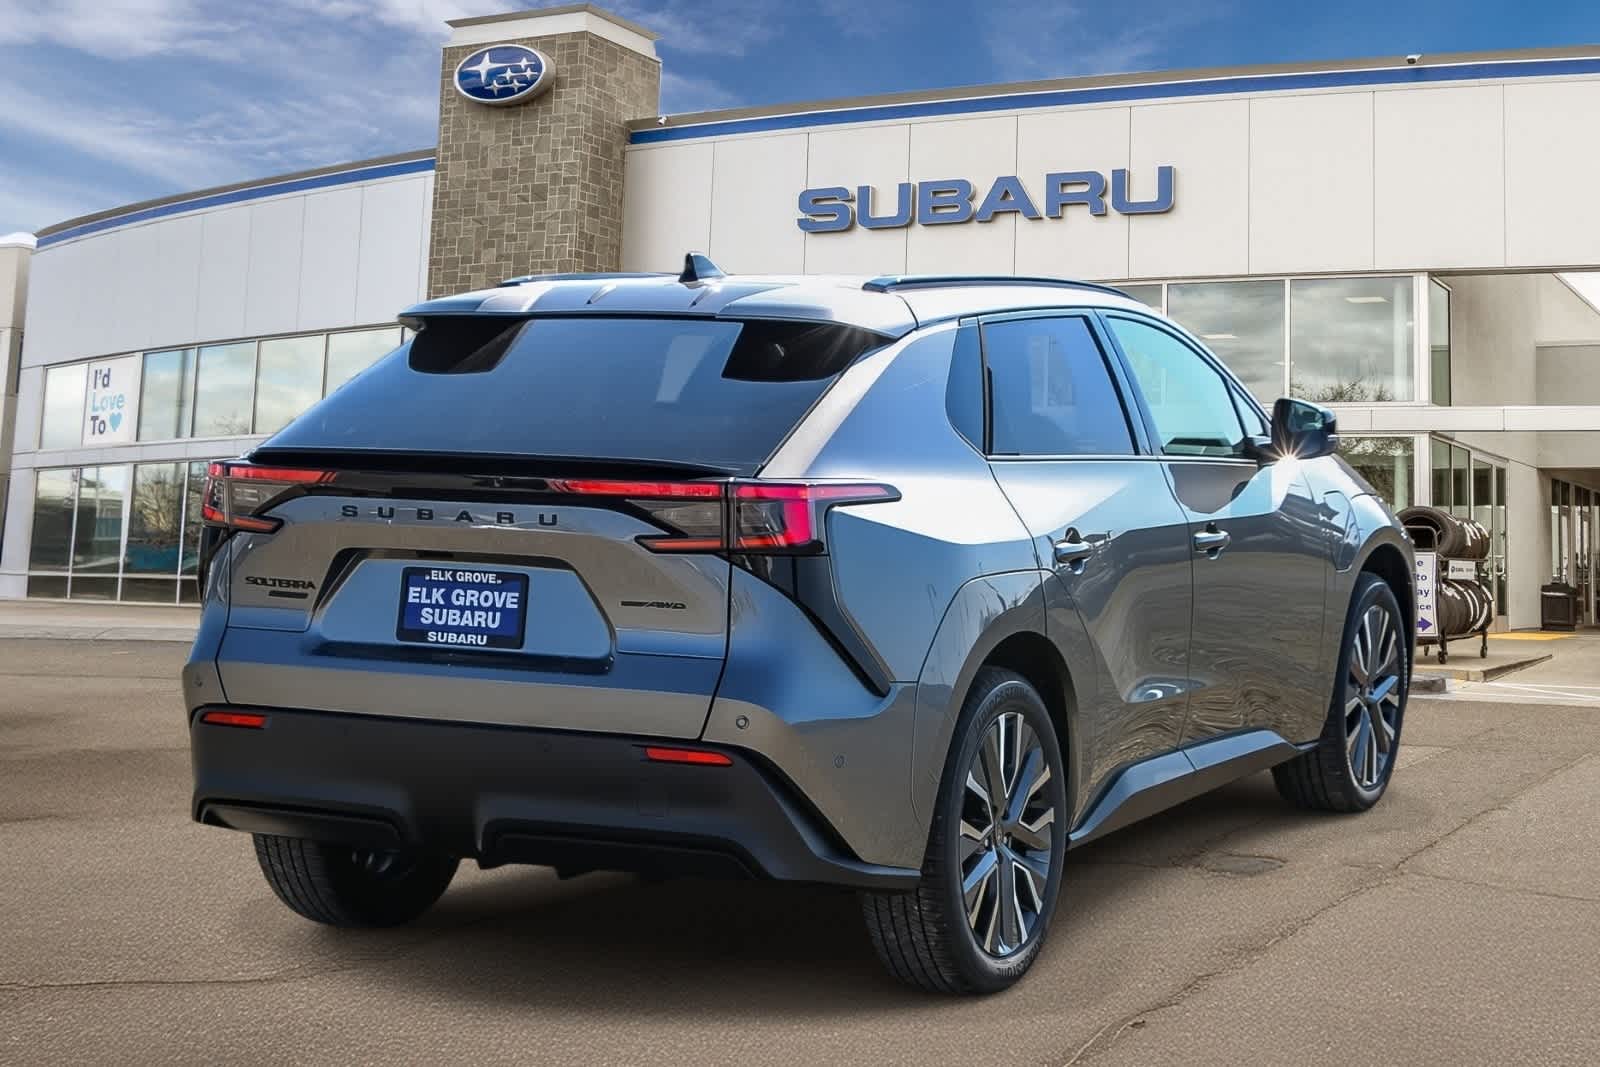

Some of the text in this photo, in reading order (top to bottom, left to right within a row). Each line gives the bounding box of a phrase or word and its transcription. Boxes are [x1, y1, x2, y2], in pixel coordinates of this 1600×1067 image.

[796, 164, 1177, 234] SUBARU
[94, 368, 111, 389] I'd
[92, 392, 125, 412] Love
[91, 416, 106, 435] To
[341, 505, 558, 526] SUBARU
[245, 576, 316, 589] SOLTERRA
[431, 570, 497, 584] ELK GROVE
[407, 587, 520, 609] ELK GROVE
[420, 607, 501, 629] SUBARU
[427, 631, 487, 646] SUBARU
